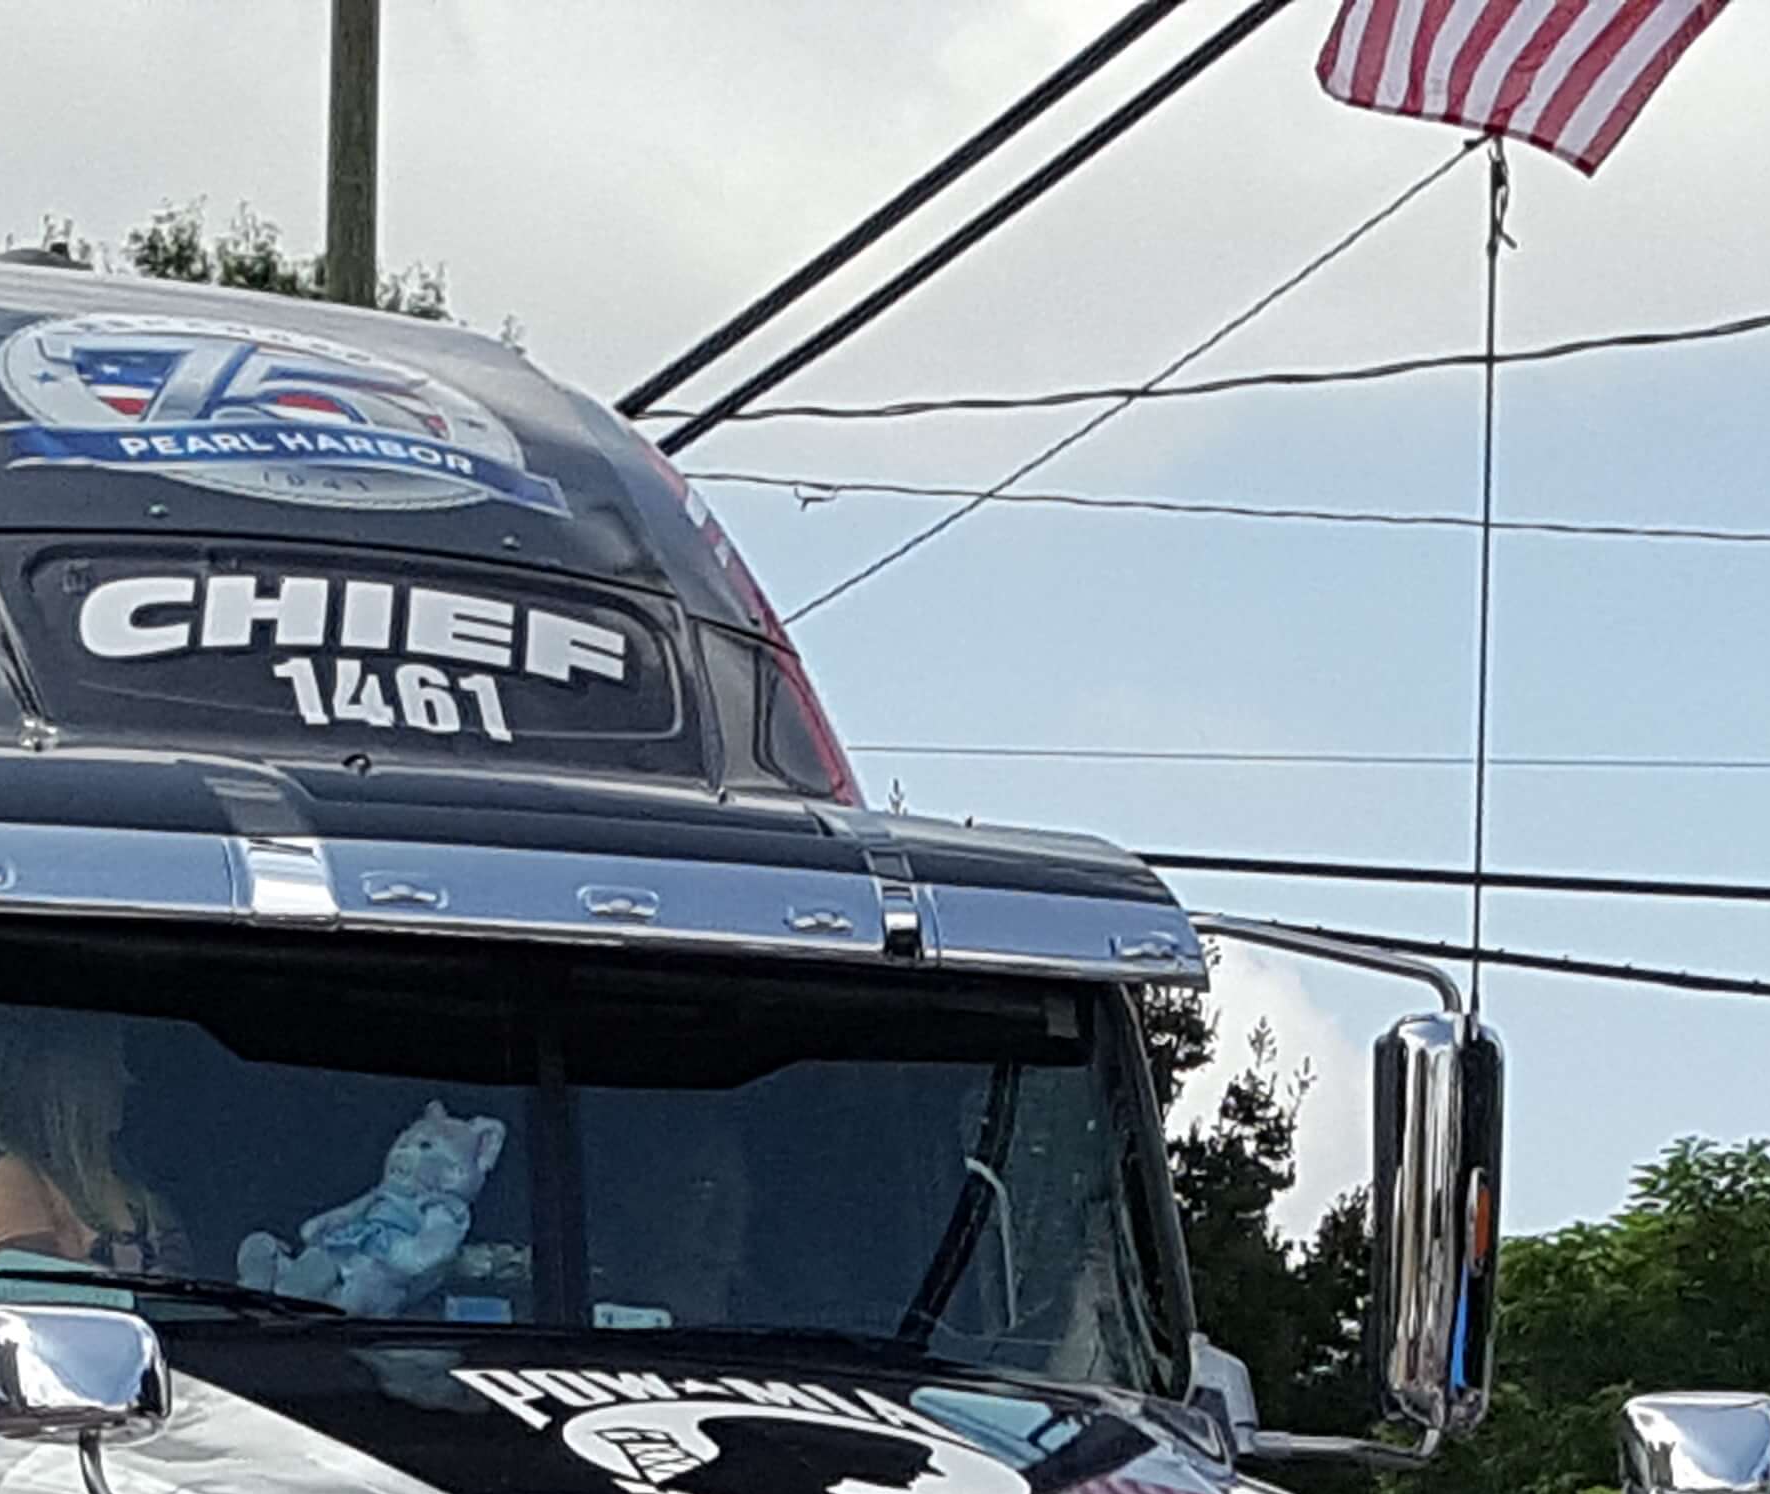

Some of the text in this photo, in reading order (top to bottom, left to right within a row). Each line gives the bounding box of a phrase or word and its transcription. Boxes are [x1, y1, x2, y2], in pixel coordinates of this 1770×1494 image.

[119, 431, 475, 475] PEARL HARBOR
[80, 575, 627, 683] CHIEF
[273, 657, 513, 743] 1461
[449, 1368, 967, 1445] POW MIA
